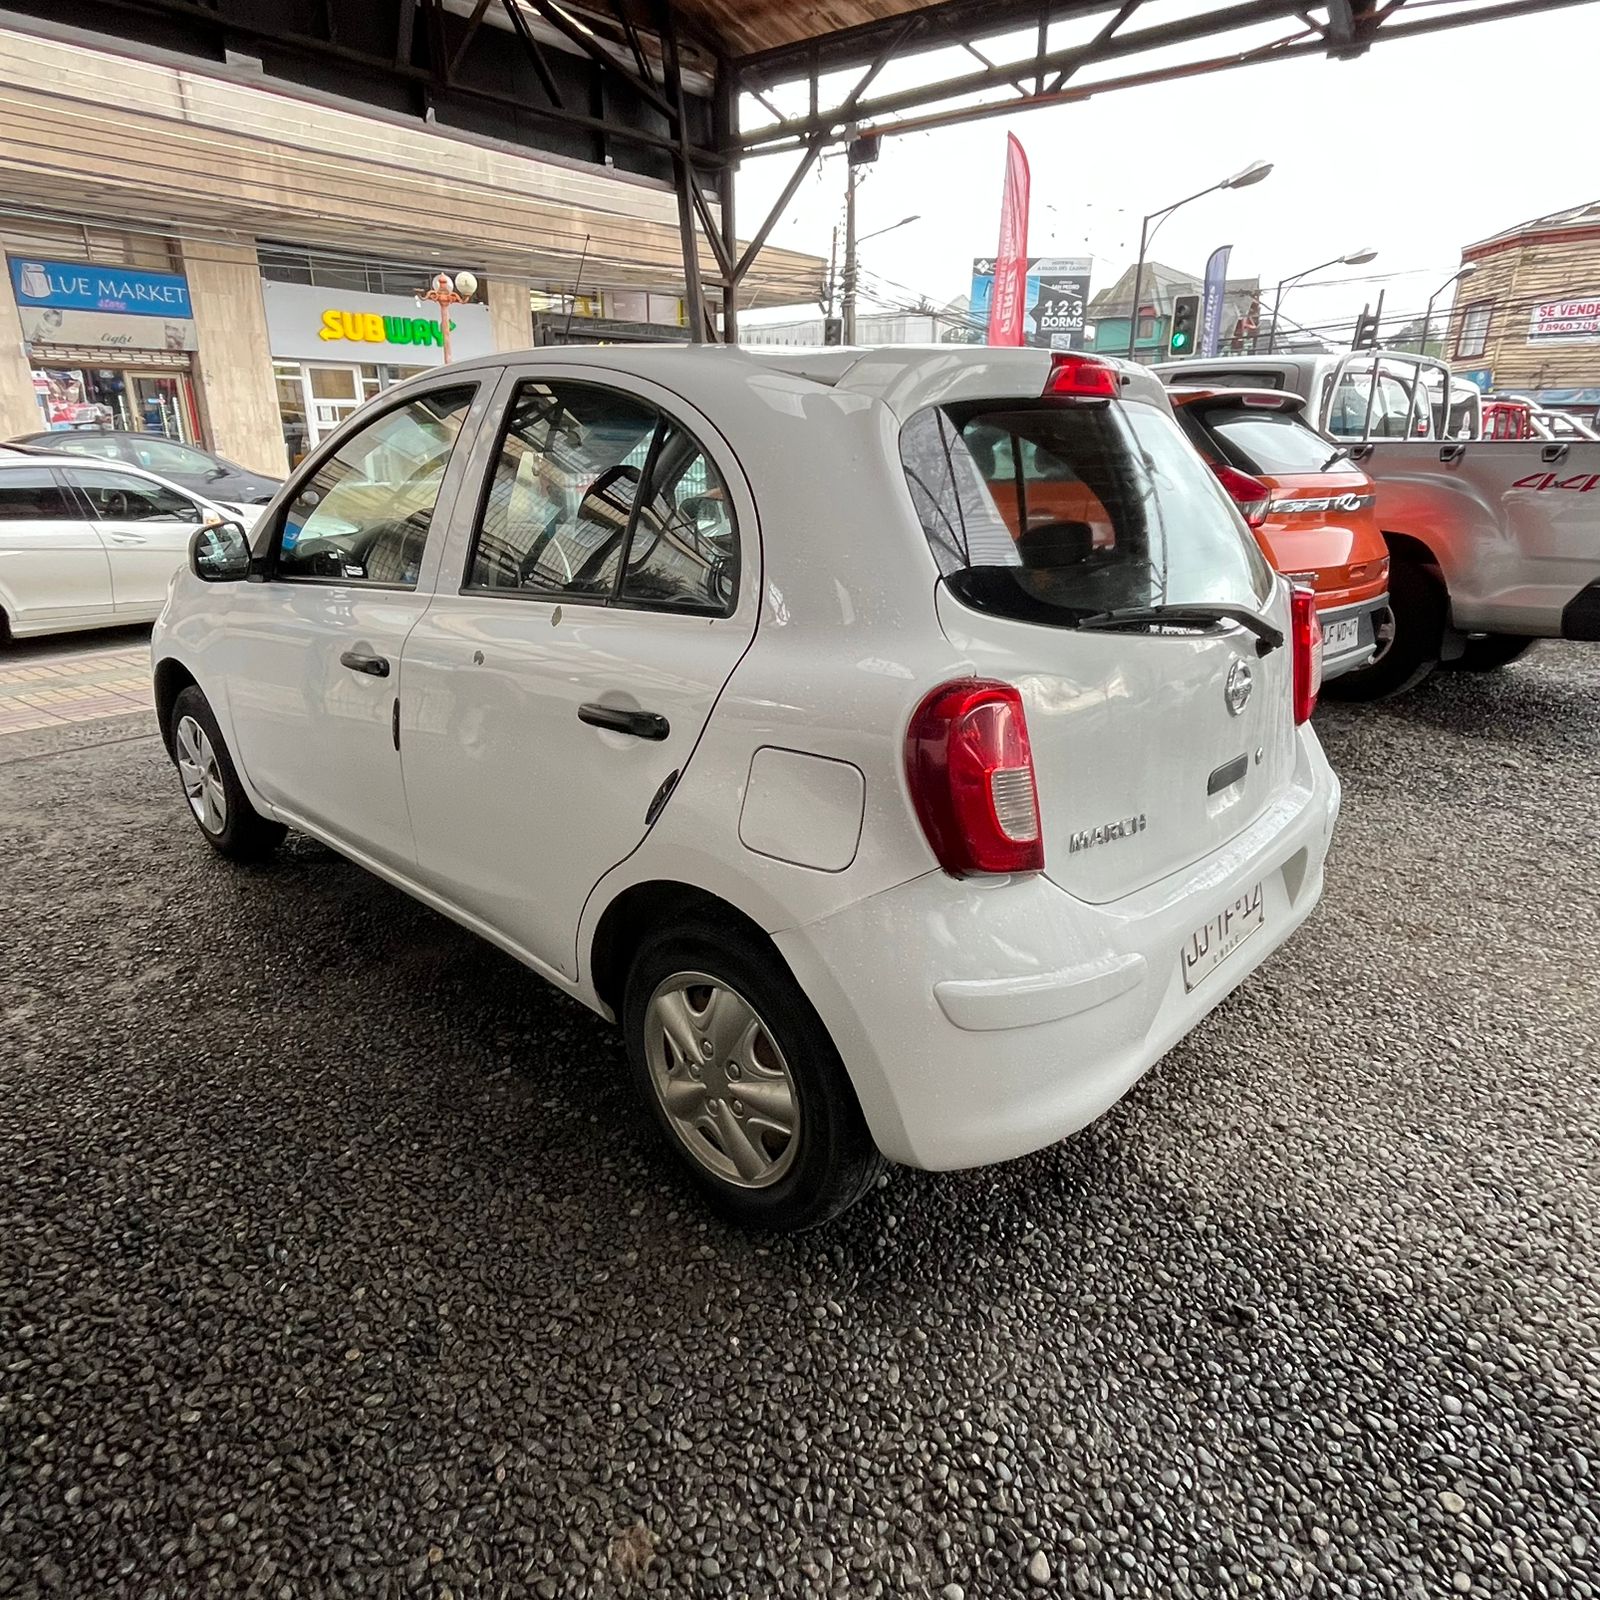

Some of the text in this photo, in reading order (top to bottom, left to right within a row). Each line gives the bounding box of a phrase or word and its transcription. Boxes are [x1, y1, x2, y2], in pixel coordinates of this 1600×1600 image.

[98, 279, 187, 304] MARKET
[1041, 316, 1084, 327] DORMS
[1539, 303, 1600, 317] SE VENDE
[318, 309, 457, 347] SUBWAY
[1069, 814, 1146, 853] MARCH
